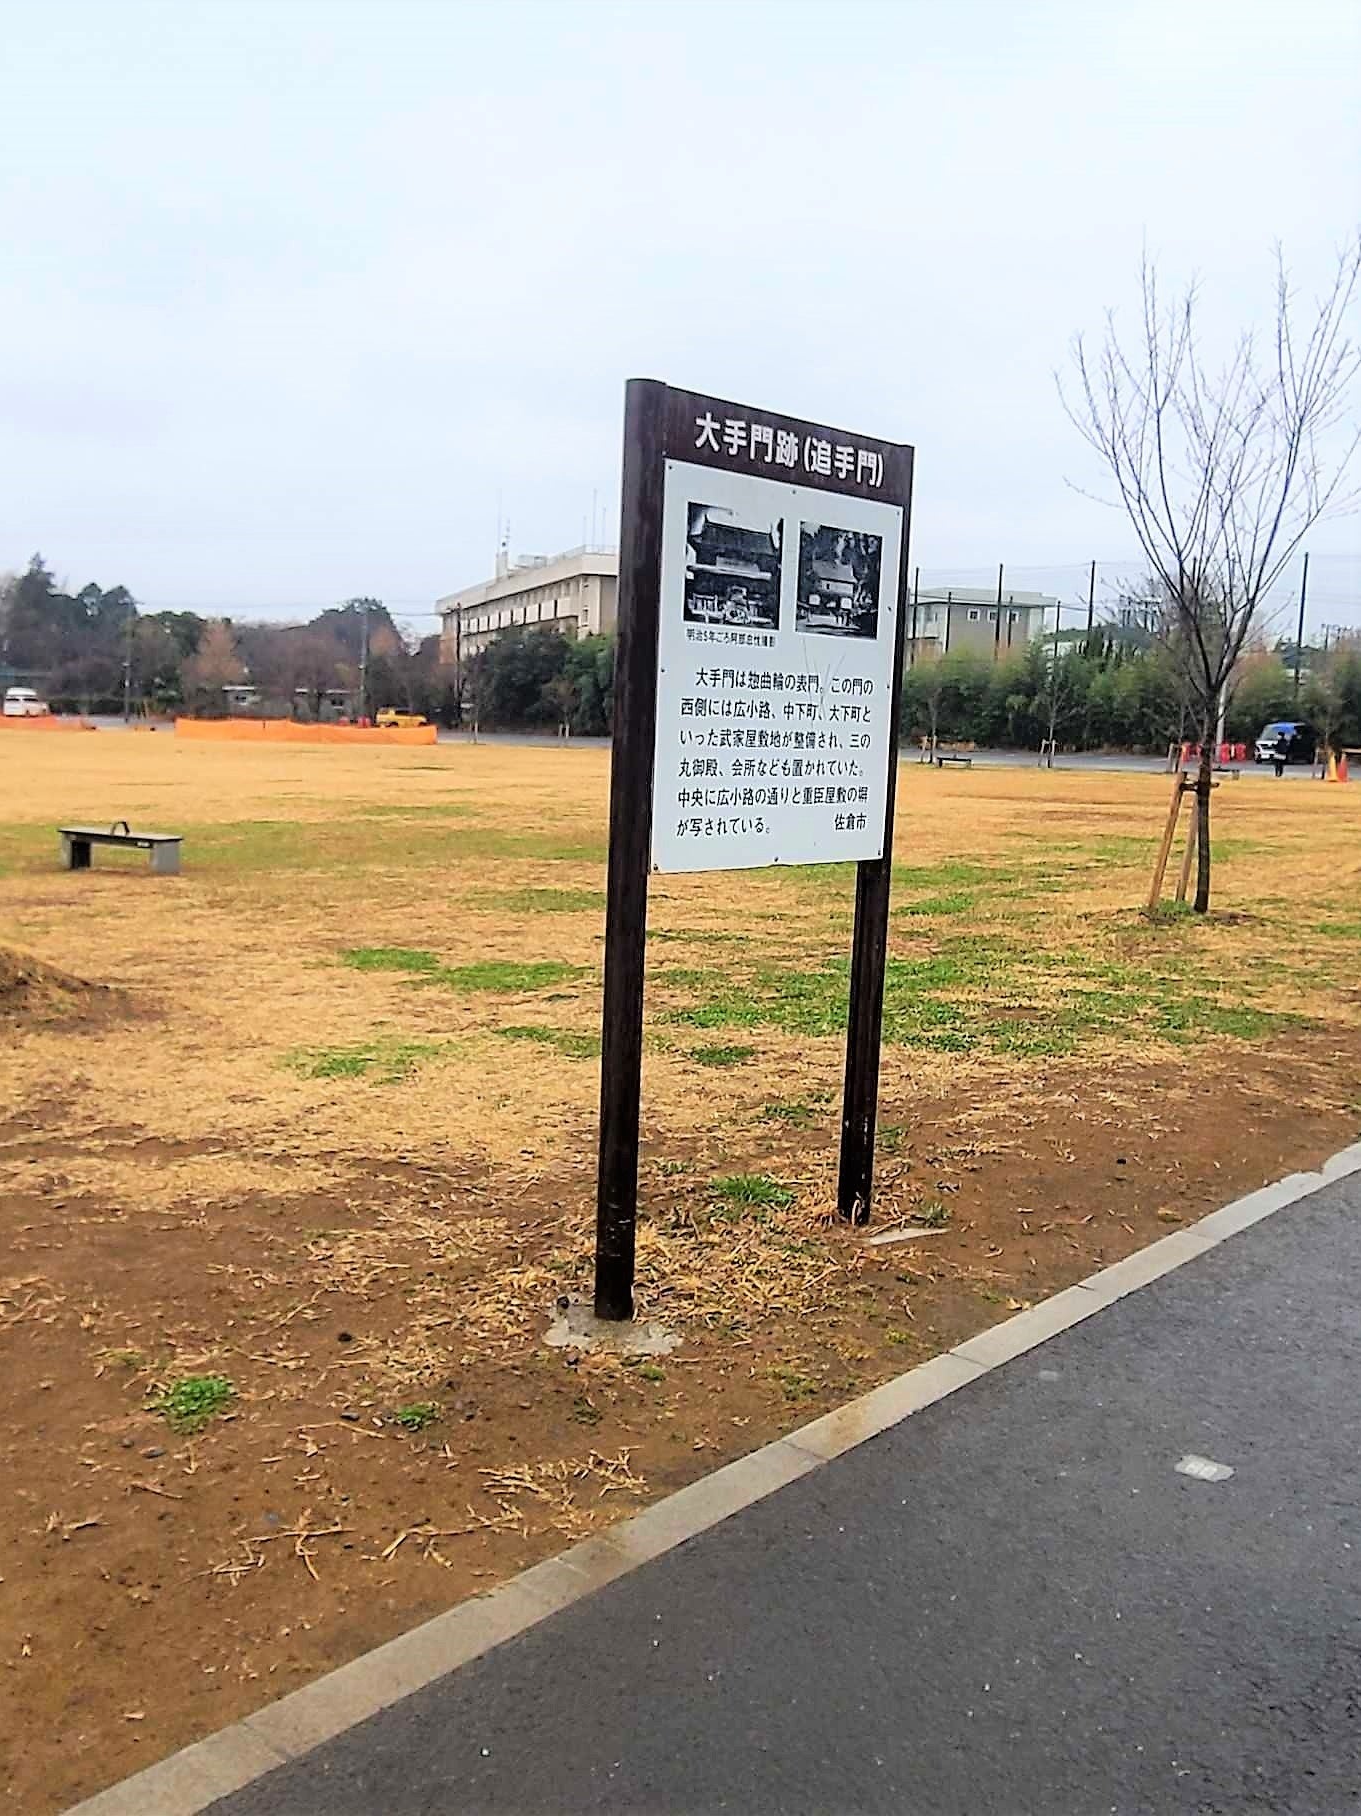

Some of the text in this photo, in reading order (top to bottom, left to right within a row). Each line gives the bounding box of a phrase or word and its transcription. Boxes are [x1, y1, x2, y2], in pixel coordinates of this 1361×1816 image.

[694, 412, 885, 487] 大手門跡(追手門)
[679, 728, 871, 750] いった武家屋敷地が整備され、三の
[678, 757, 864, 777] 丸御殿、会所なども置かれていた。
[676, 817, 771, 837] が写されている。
[834, 813, 868, 832] 佐倉市
